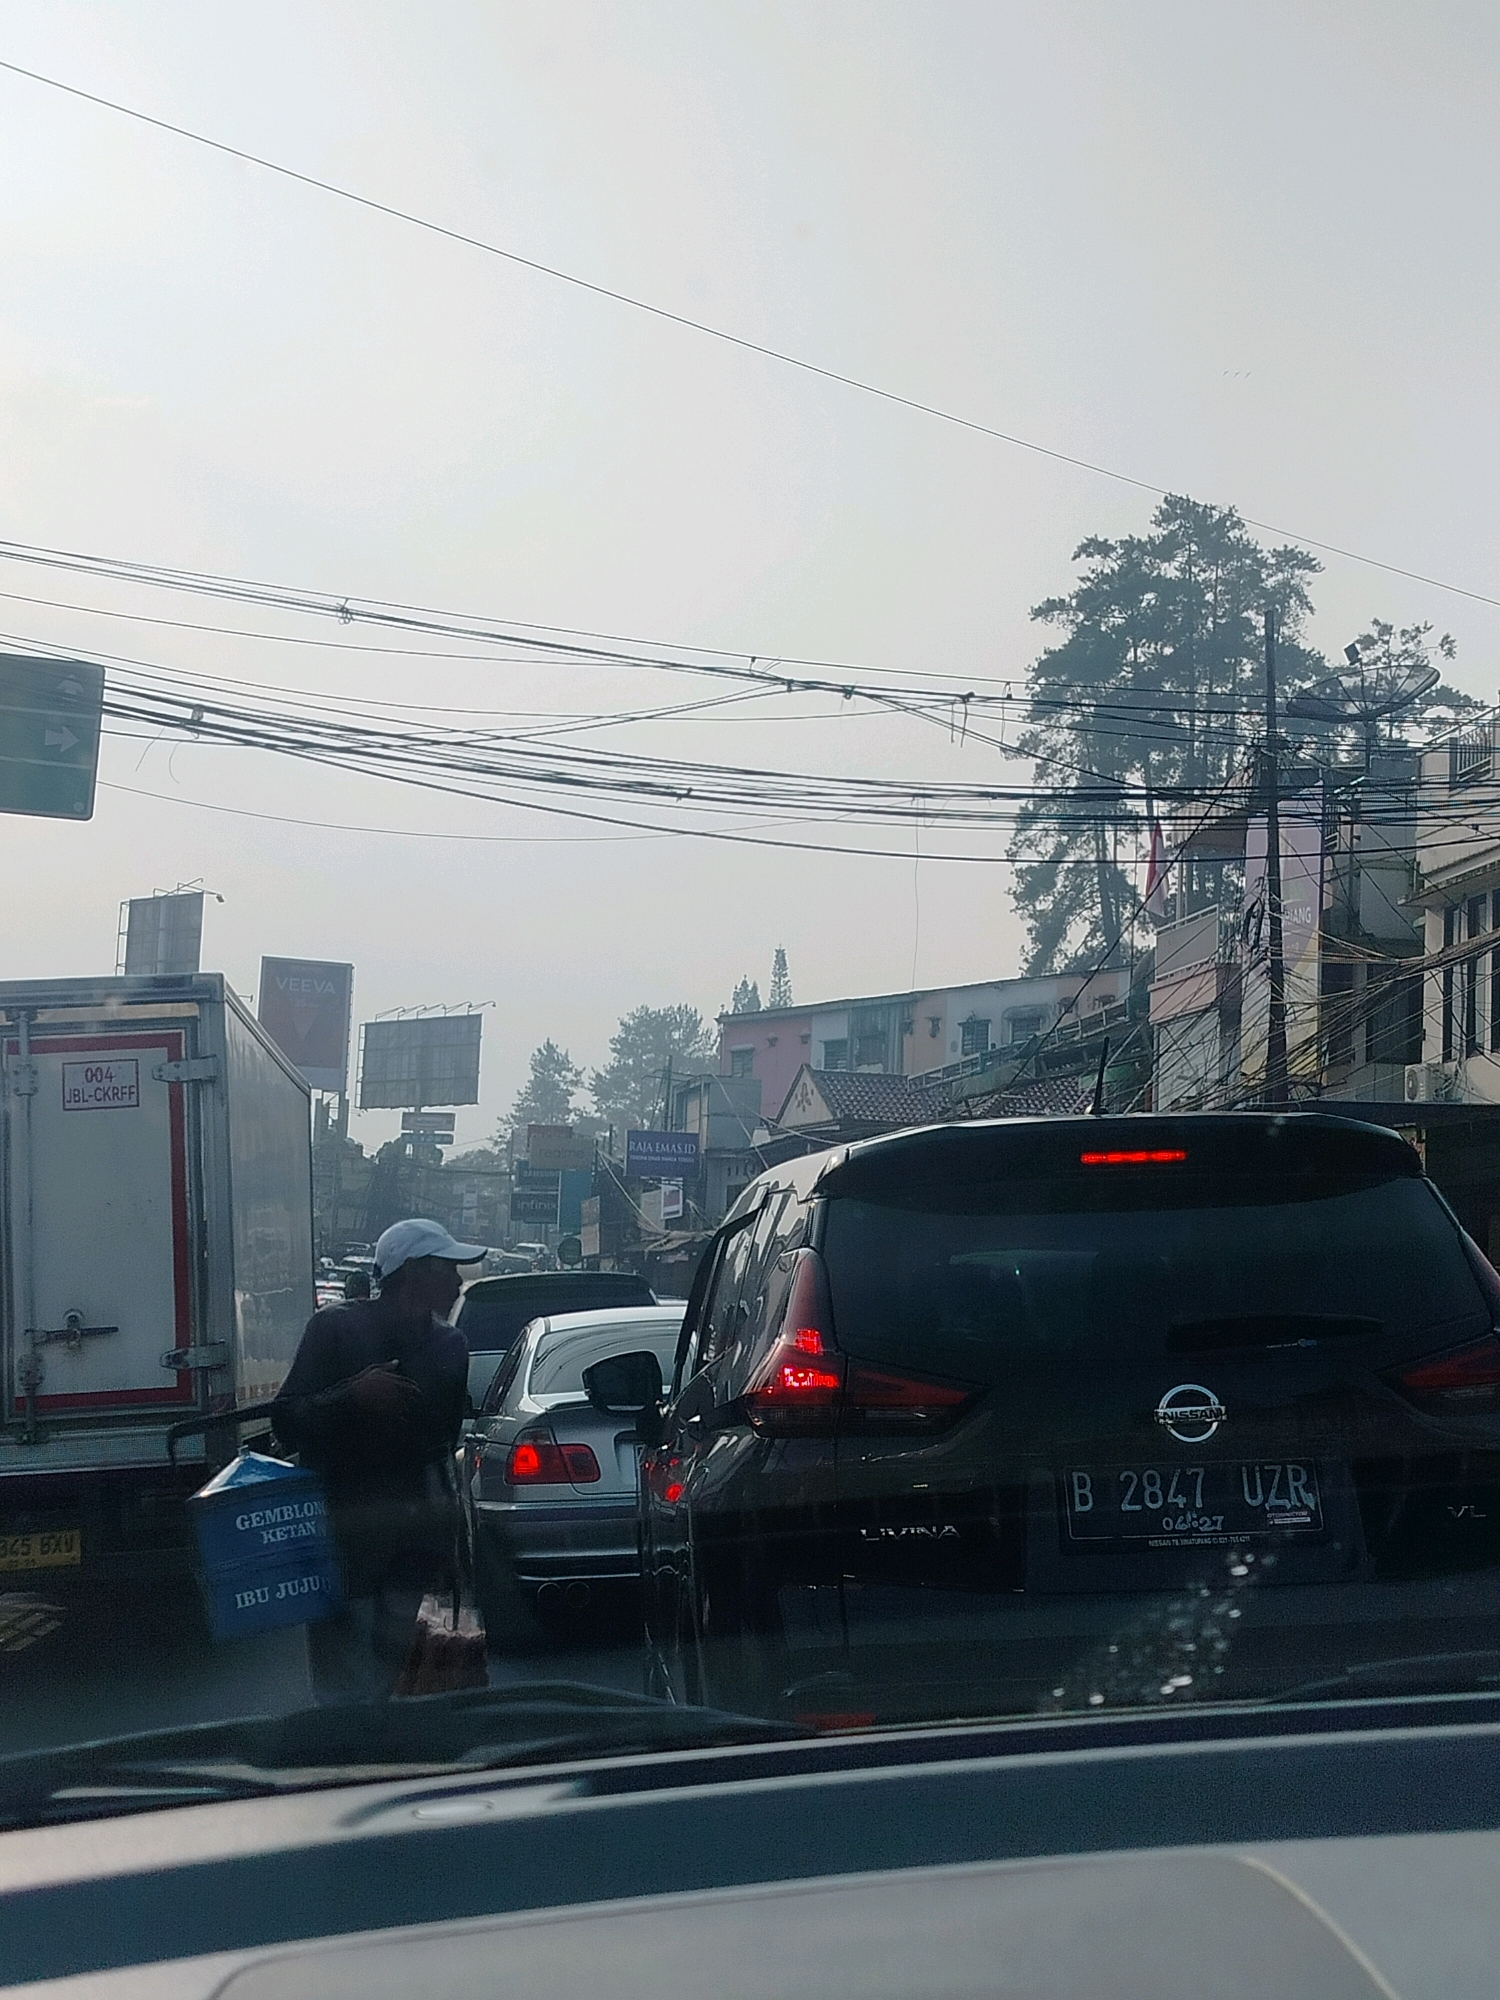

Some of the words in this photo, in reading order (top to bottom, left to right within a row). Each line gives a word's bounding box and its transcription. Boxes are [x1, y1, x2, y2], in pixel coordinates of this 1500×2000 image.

[274, 976, 336, 994] VEEVA
[85, 1066, 115, 1083] 004
[66, 1085, 136, 1103] JBL-CKRFF
[629, 1141, 653, 1153] RAJA
[1163, 1407, 1221, 1421] NISSAN
[1072, 1471, 1094, 1512] B
[1118, 1468, 1205, 1511] 2847
[1241, 1465, 1311, 1508] UZR
[1447, 1505, 1487, 1518] VL
[261, 1520, 317, 1544] KETAN
[860, 1525, 961, 1541] LIVINA
[235, 1587, 270, 1609] IBU
[276, 1575, 320, 1600] JUJU
